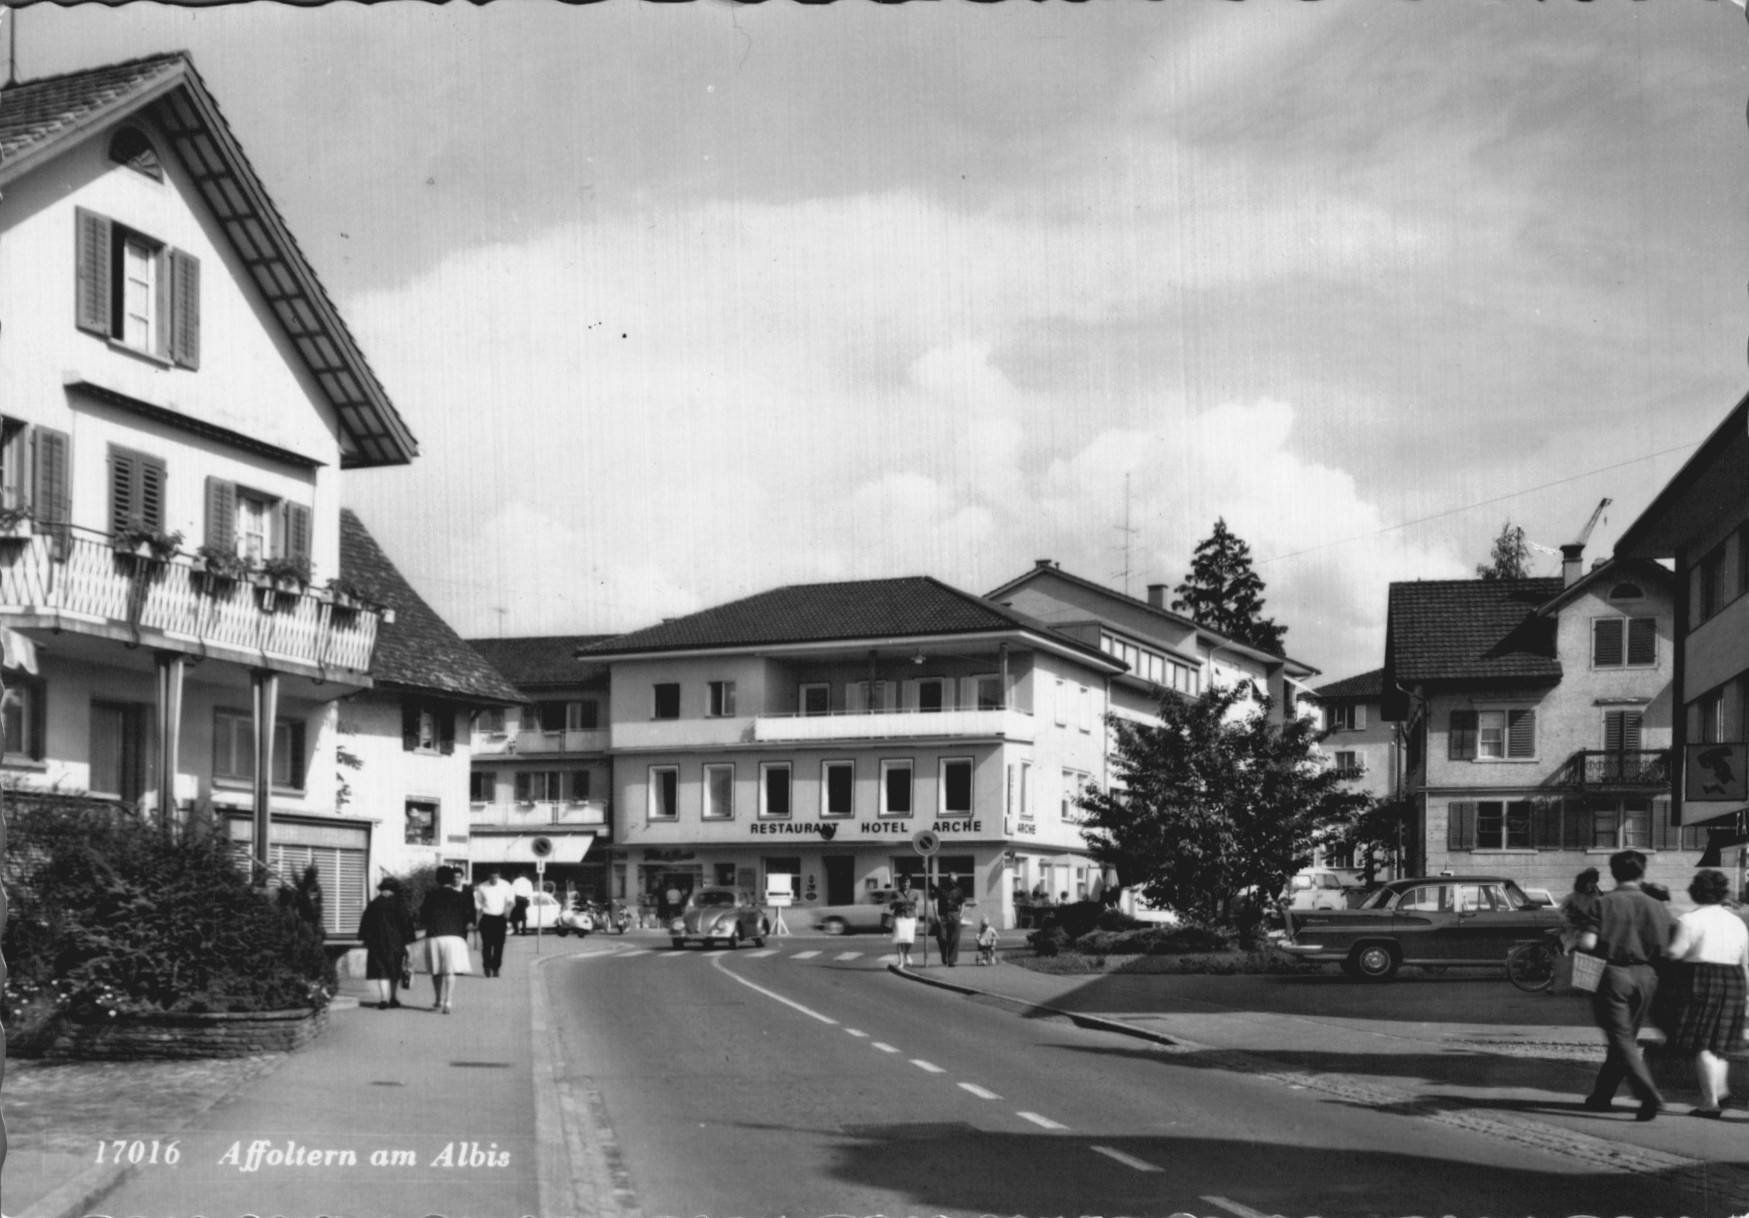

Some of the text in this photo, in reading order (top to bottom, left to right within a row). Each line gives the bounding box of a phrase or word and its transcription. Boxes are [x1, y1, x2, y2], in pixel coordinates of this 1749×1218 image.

[861, 821, 909, 834] HOTEL
[932, 820, 983, 833] ARCHE
[1017, 823, 1036, 835] ARCHE
